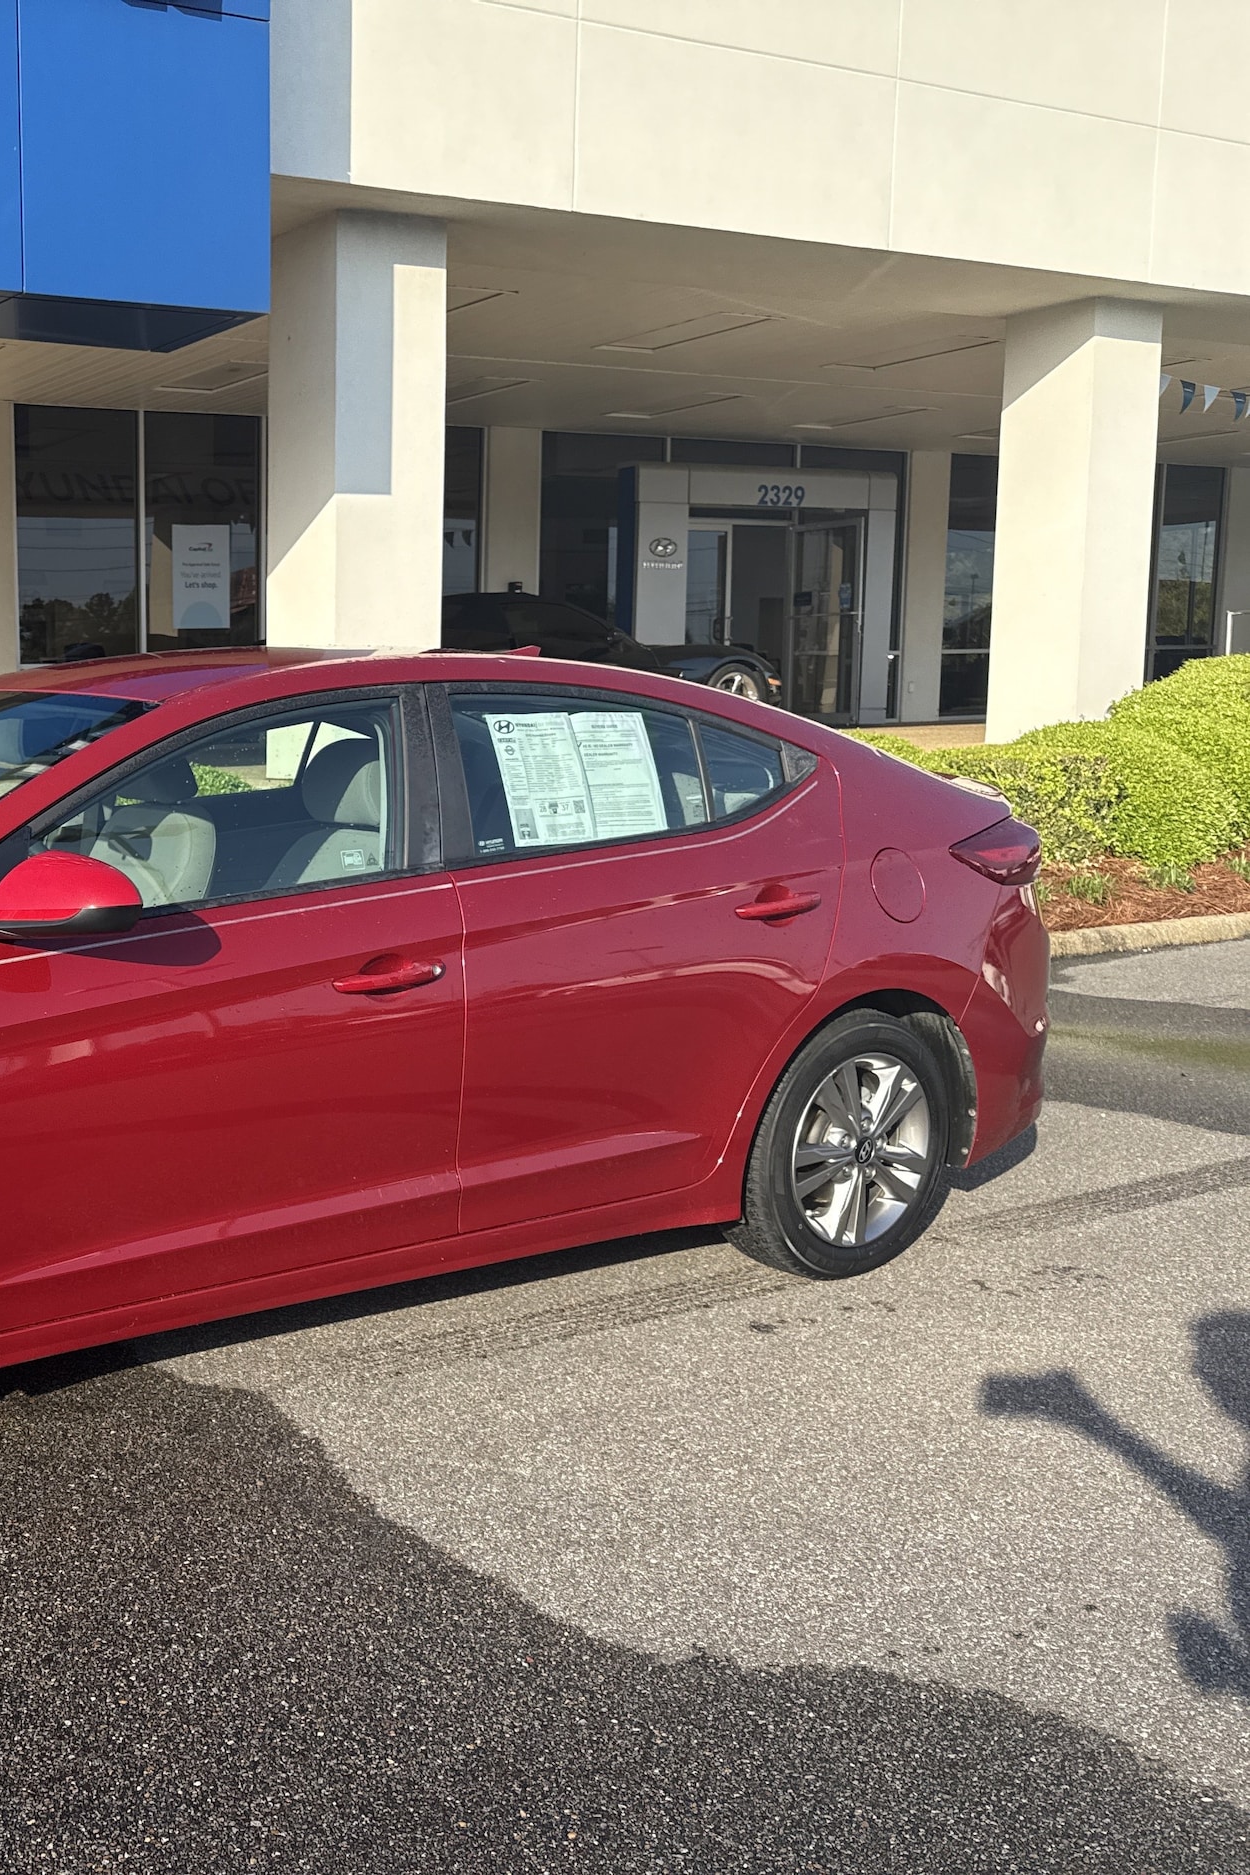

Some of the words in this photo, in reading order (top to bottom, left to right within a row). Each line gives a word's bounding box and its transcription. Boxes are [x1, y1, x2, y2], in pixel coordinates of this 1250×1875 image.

[757, 484, 805, 507] 2329
[184, 581, 200, 589] Let's
[201, 581, 219, 590] shop.
[539, 805, 548, 813] 28
[561, 803, 570, 811] 37
